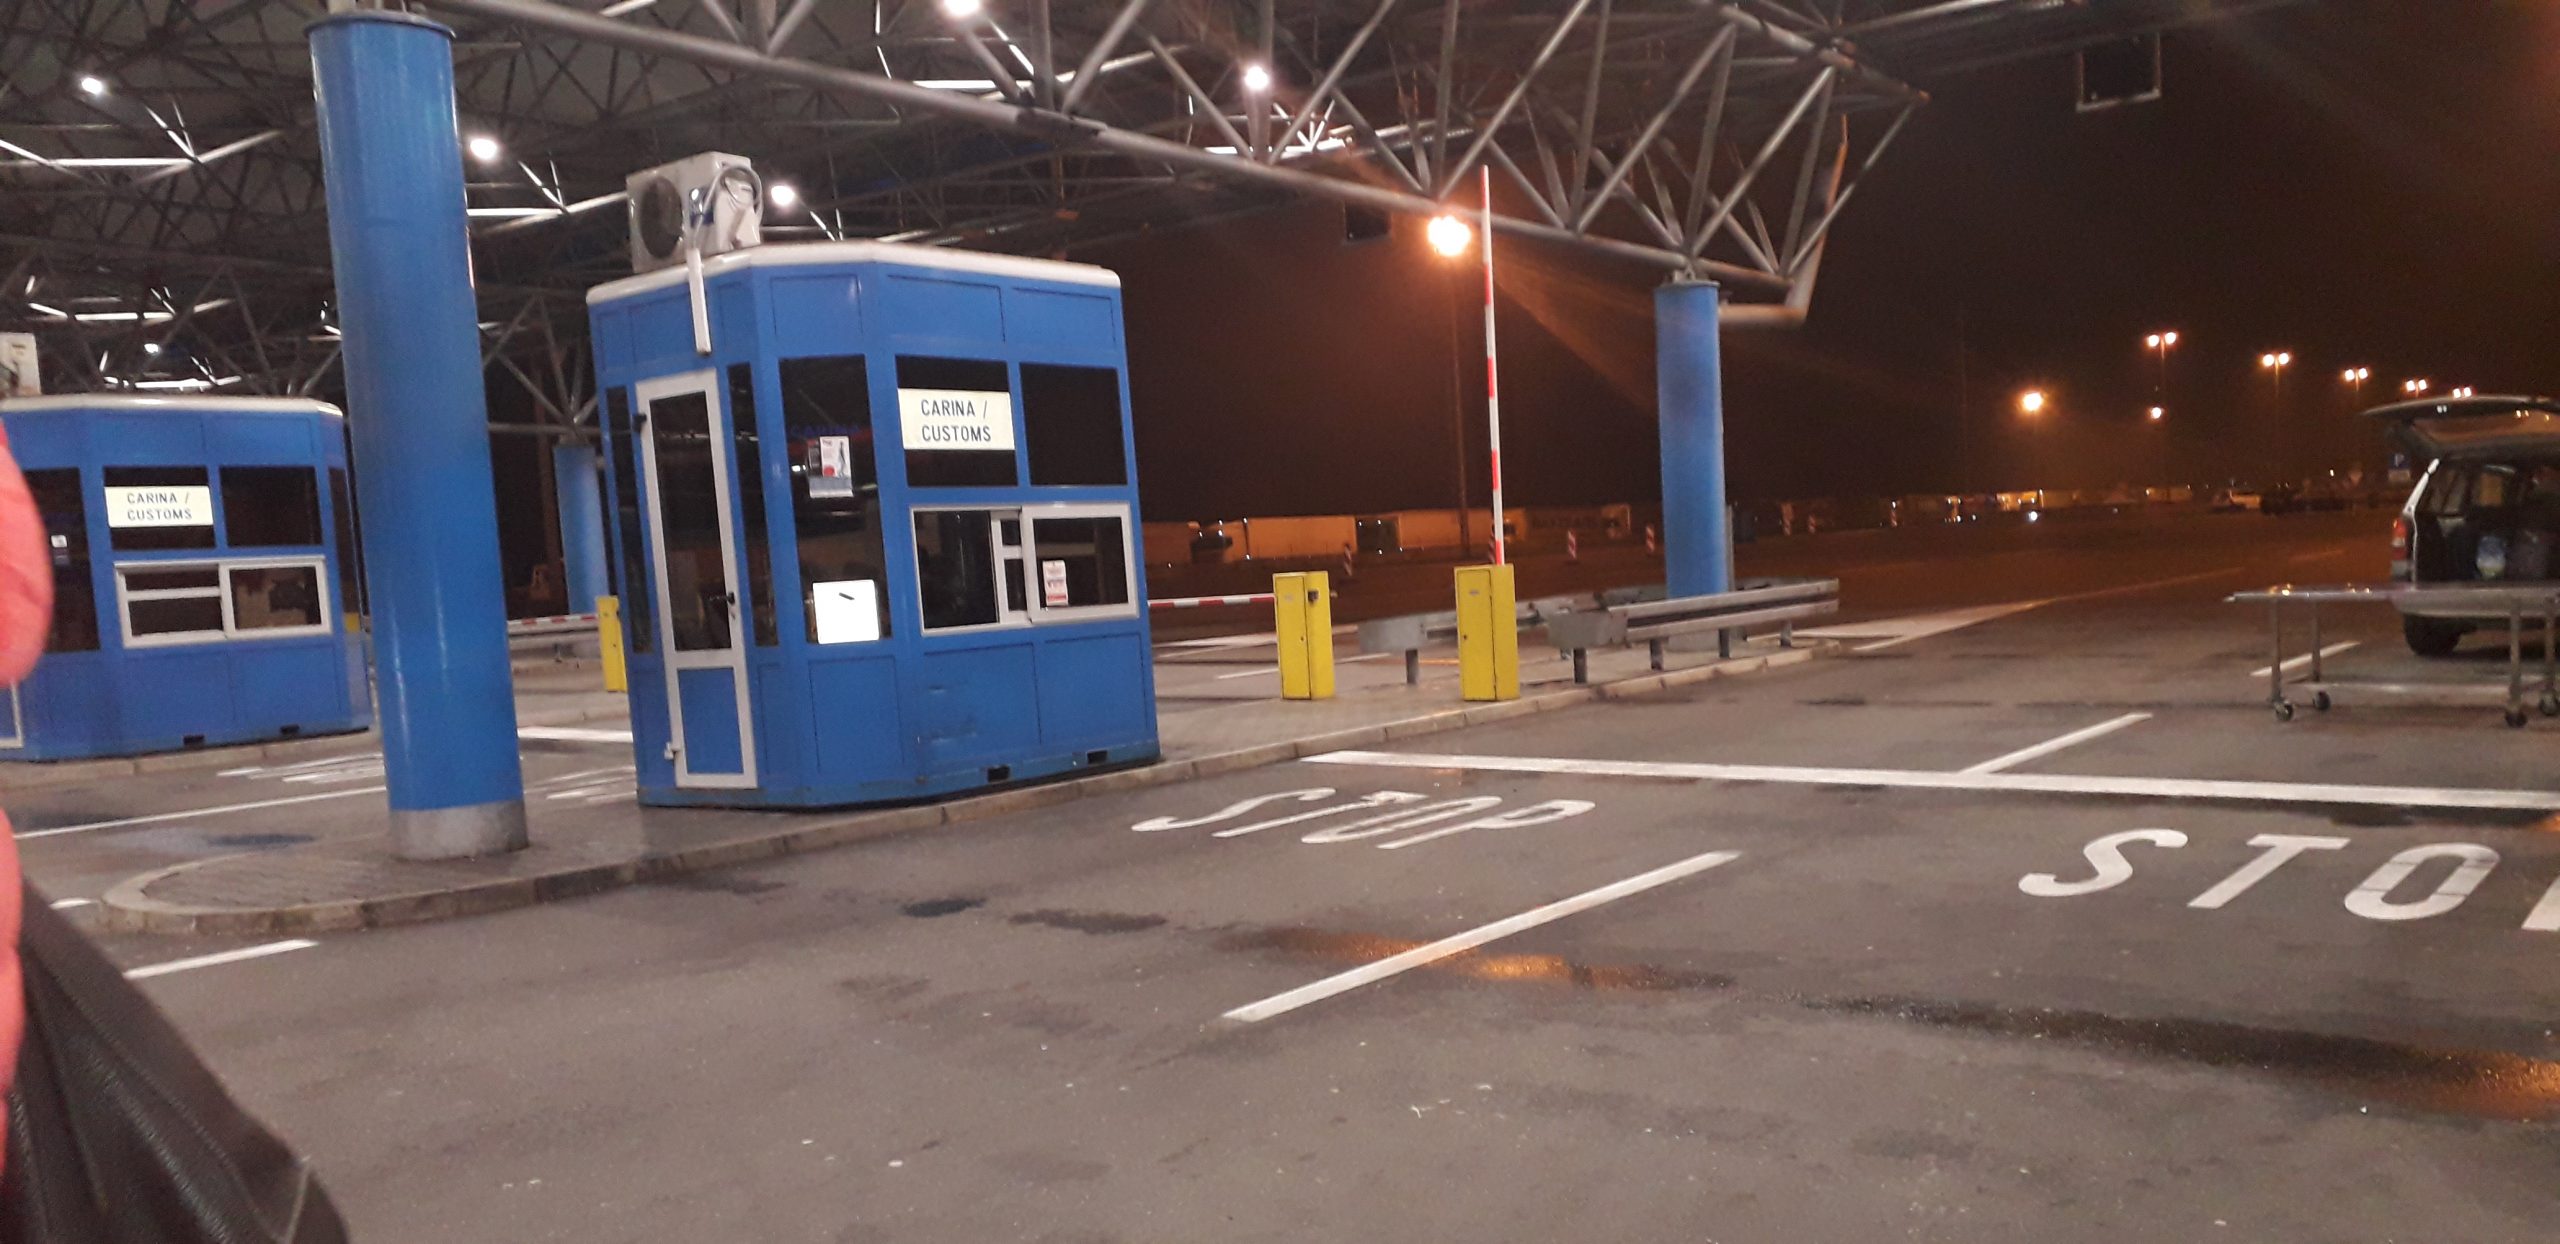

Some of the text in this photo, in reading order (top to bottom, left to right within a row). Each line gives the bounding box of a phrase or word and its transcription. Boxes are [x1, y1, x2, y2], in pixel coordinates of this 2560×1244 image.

[921, 399, 988, 419] CARINA /
[921, 425, 992, 442] CUSTOMS
[126, 492, 178, 504] CARINA
[126, 508, 193, 521] CUSTOMS
[1131, 786, 1596, 850] STOP
